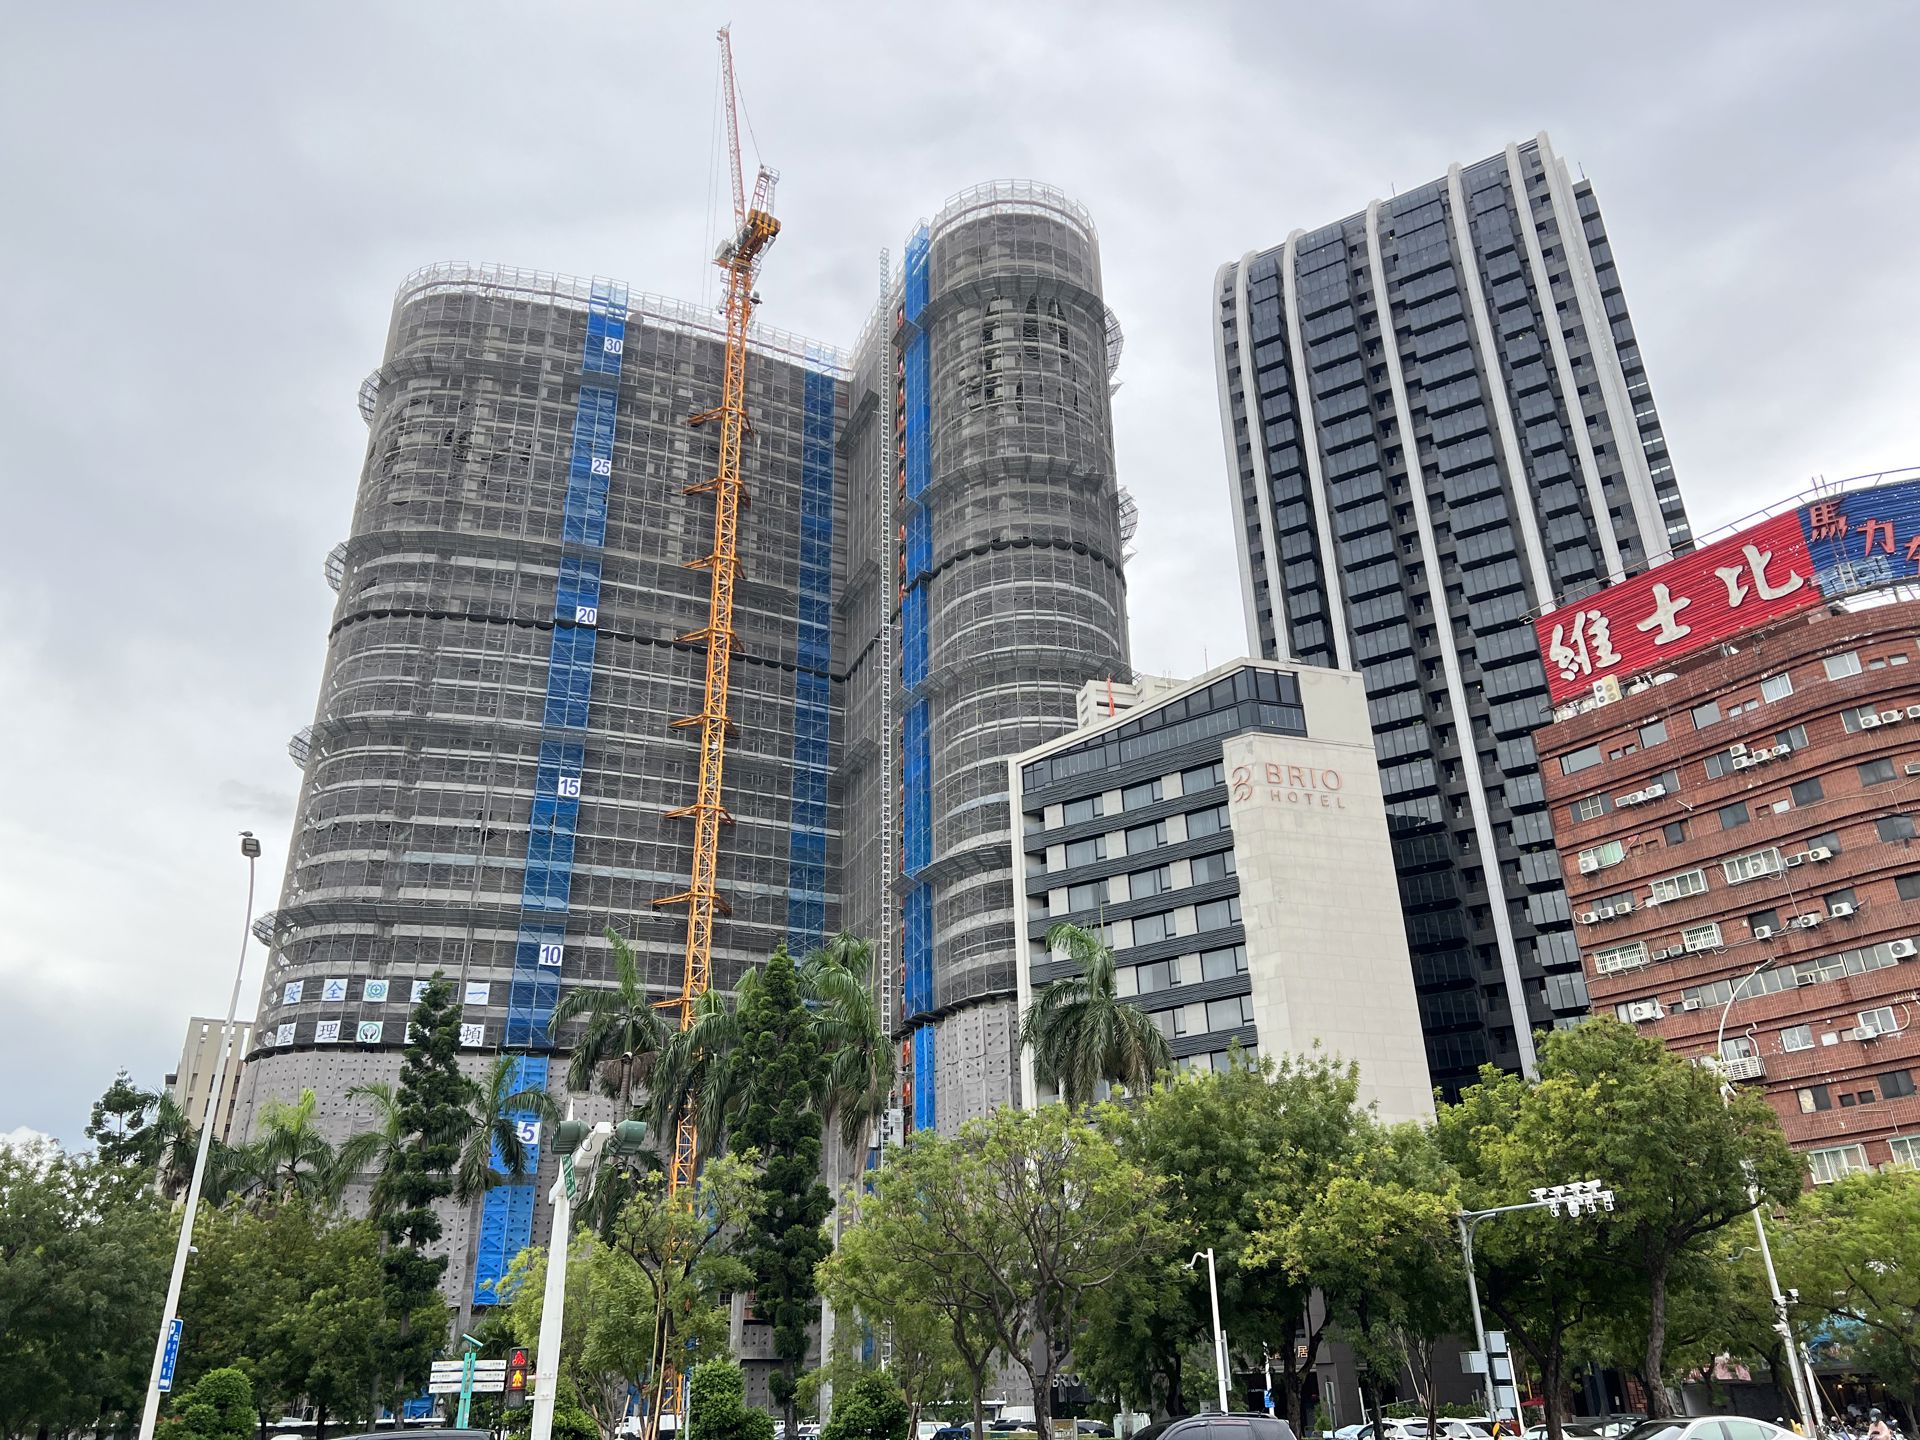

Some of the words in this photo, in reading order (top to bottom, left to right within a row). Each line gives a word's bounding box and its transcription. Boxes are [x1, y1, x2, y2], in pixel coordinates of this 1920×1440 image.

[606, 339, 622, 353] 30
[593, 459, 610, 475] 25
[578, 608, 595, 624] 20
[1550, 544, 1804, 681] 維士比
[1265, 763, 1342, 791] BRIO
[560, 778, 579, 796] 15
[1270, 789, 1345, 809] HOTEL
[542, 946, 561, 964] 10
[285, 981, 344, 1001] 安全
[278, 1023, 338, 1045] 整理
[521, 1123, 535, 1142] 5
[1053, 1373, 1080, 1388] BRIO
